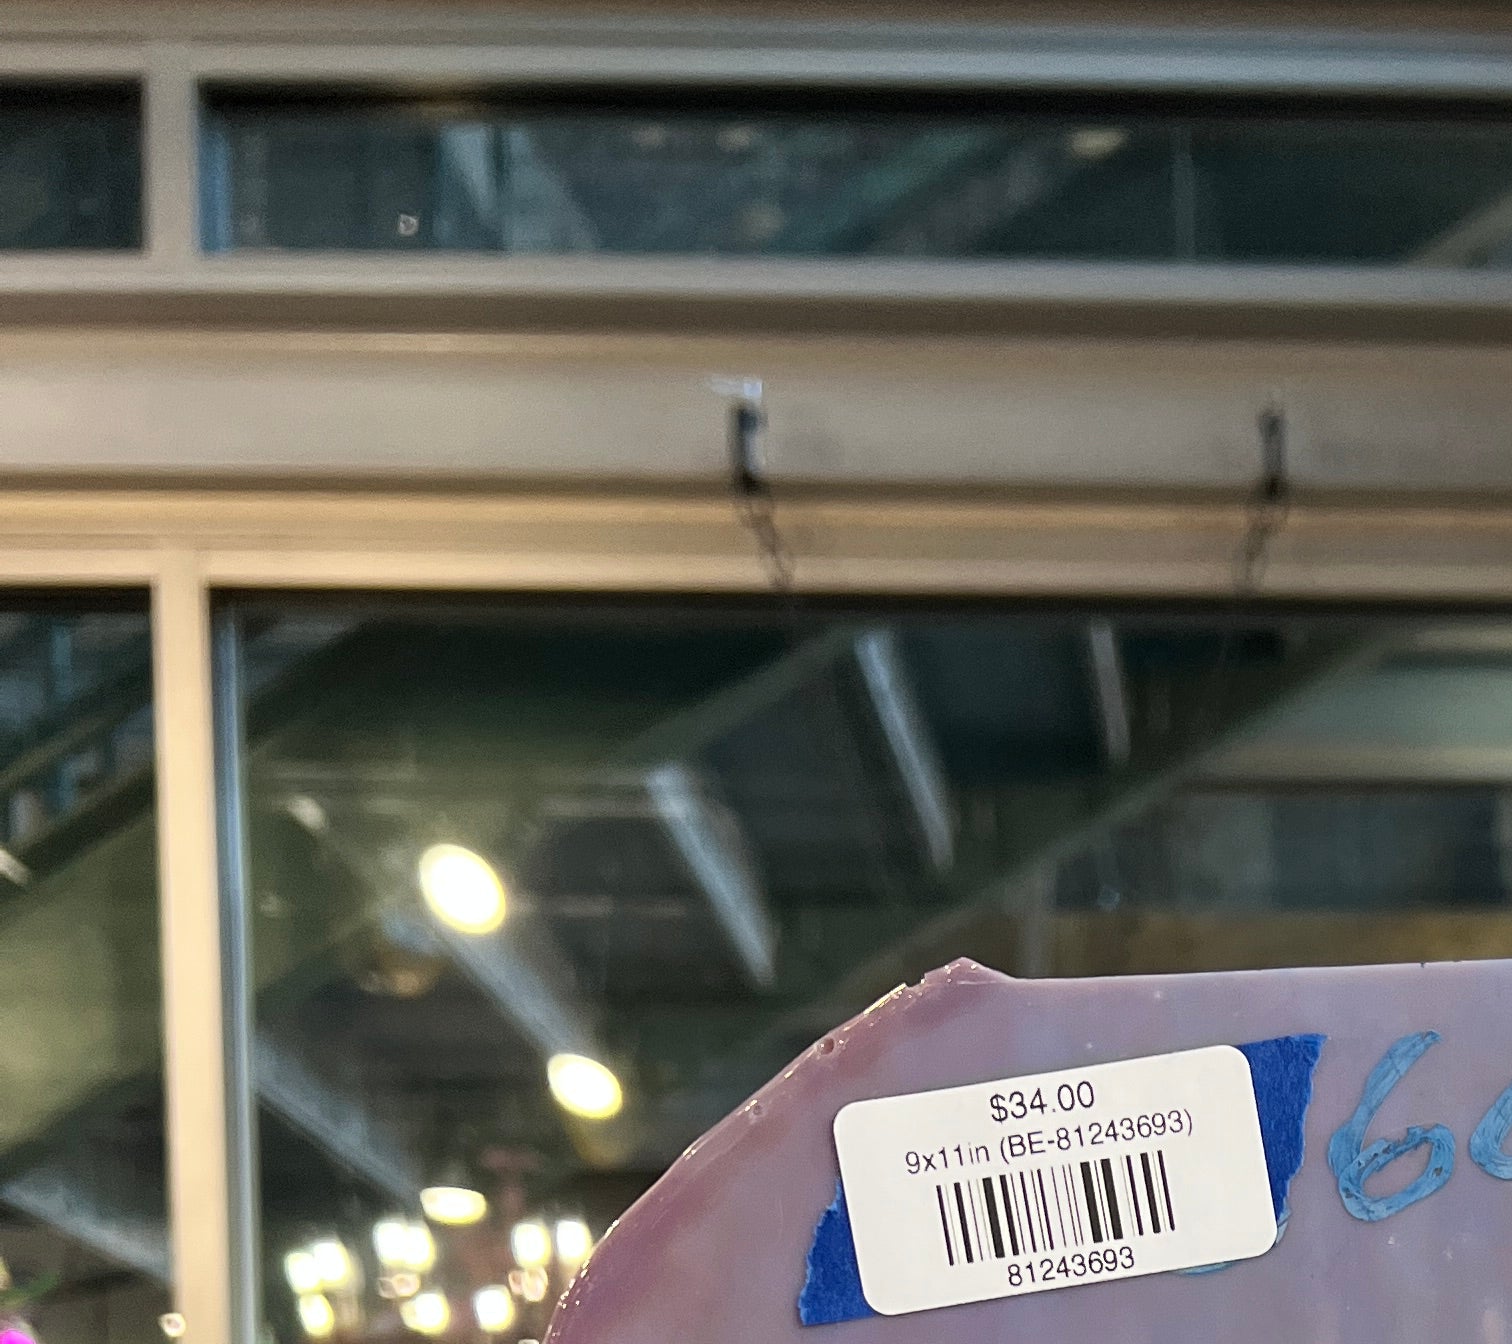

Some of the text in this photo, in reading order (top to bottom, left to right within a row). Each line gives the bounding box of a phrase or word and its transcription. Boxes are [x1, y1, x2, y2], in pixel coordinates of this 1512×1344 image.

[989, 1080, 1095, 1124] $34.00
[905, 1108, 1193, 1175] 9x11in (BE-81243693)
[1007, 1246, 1135, 1287] 81243693
